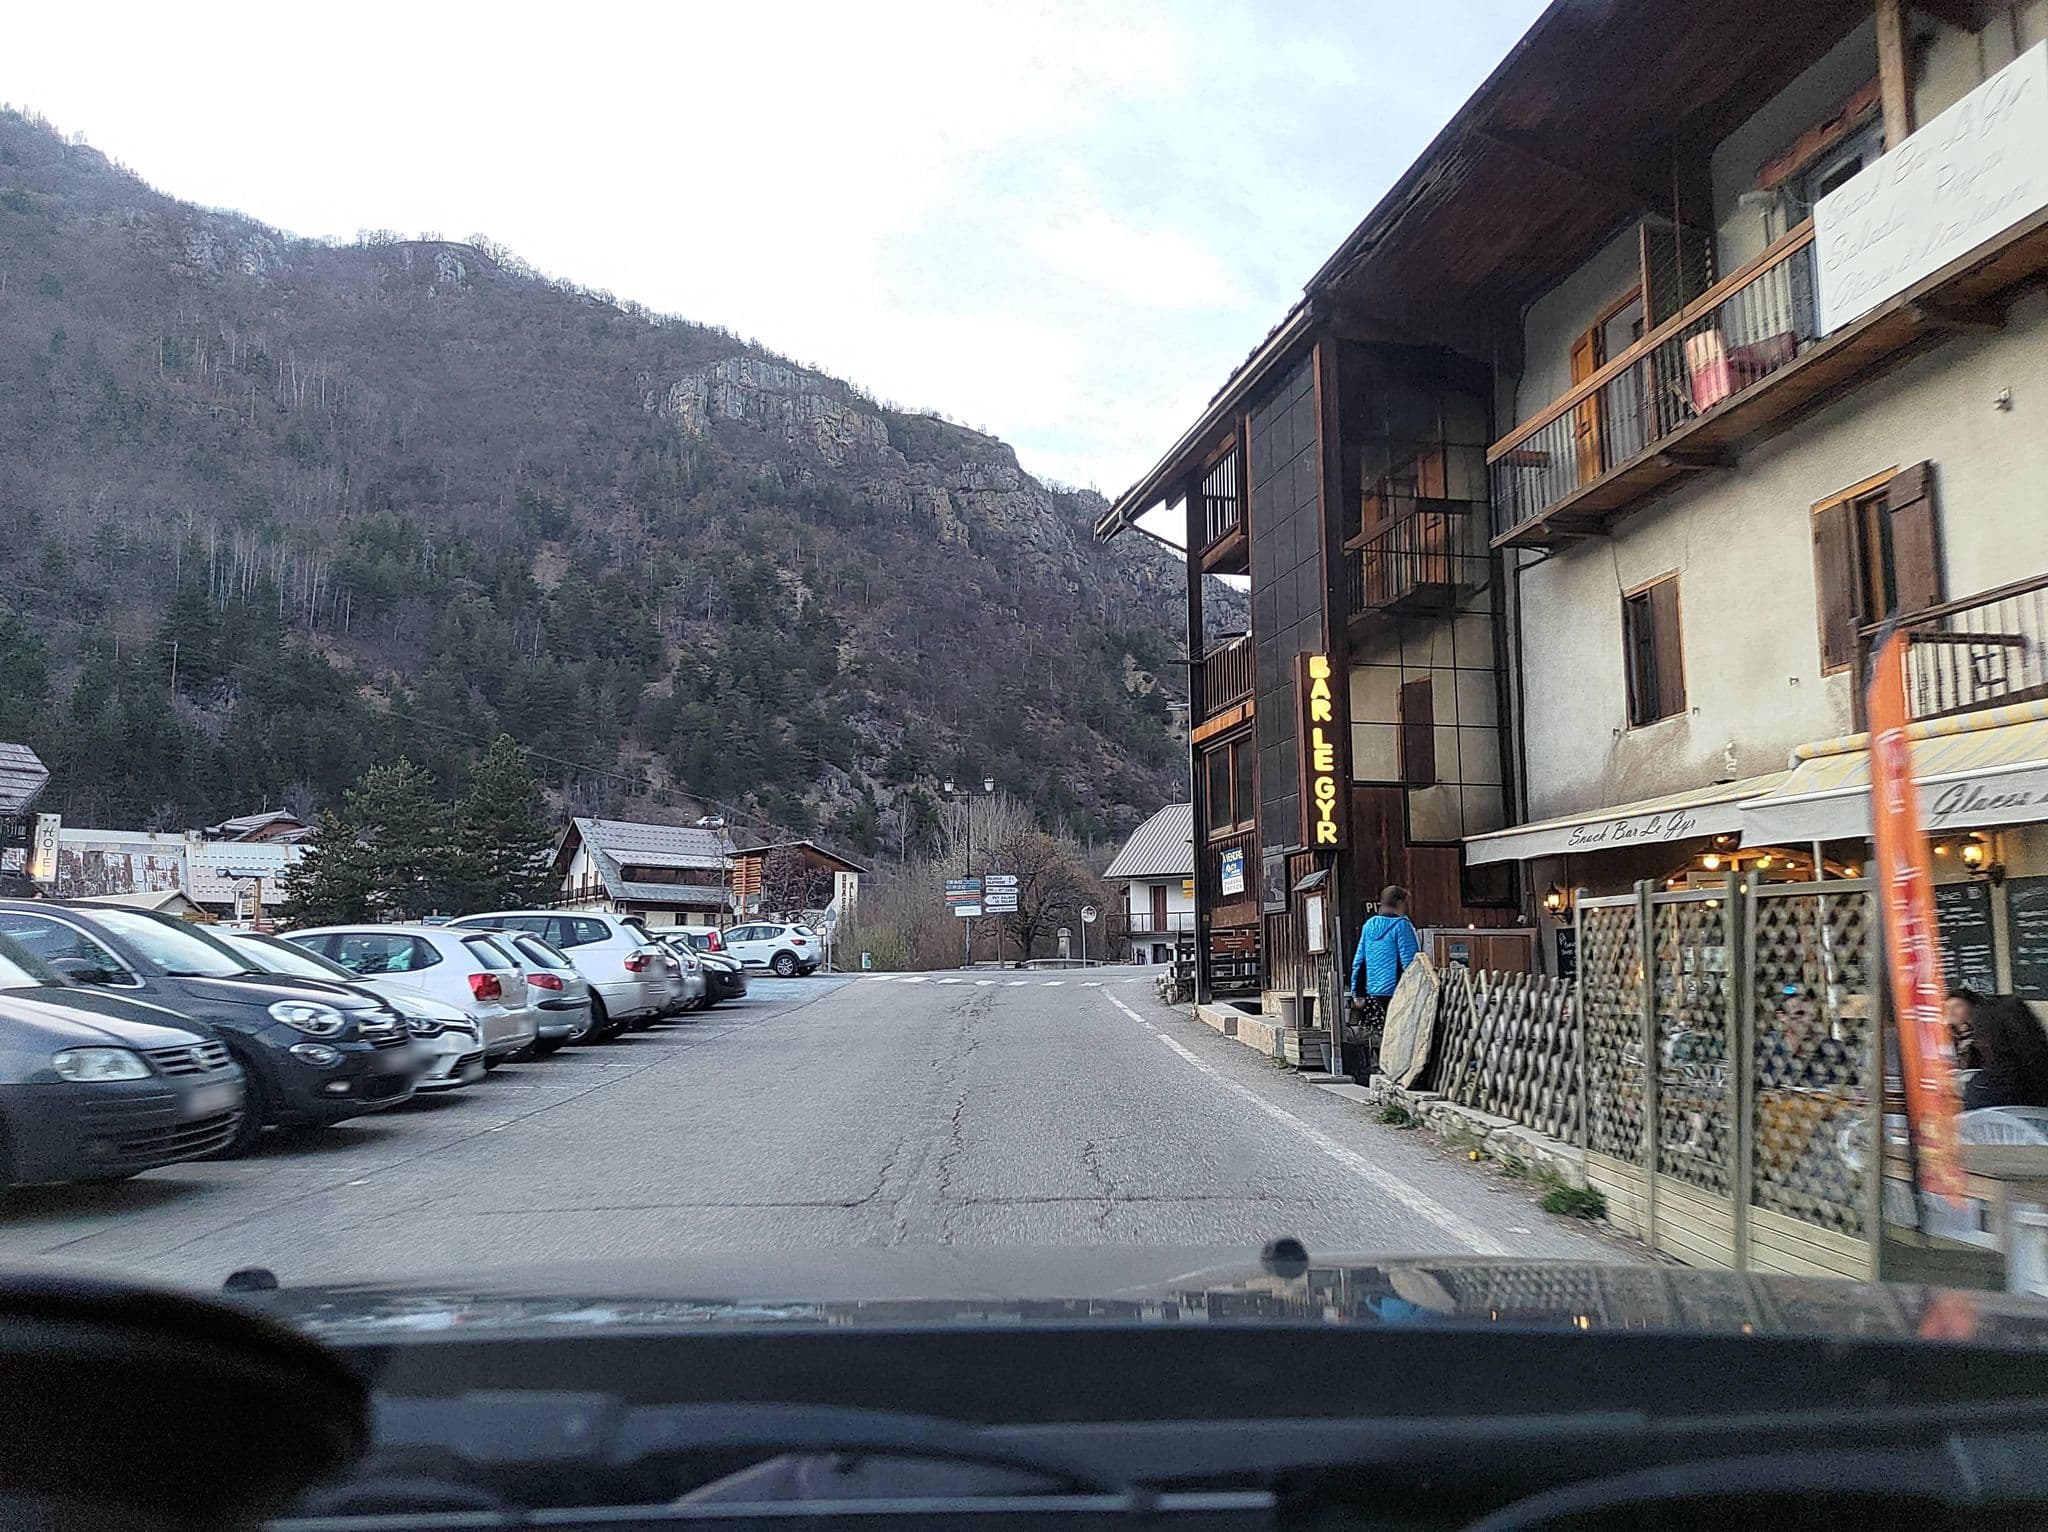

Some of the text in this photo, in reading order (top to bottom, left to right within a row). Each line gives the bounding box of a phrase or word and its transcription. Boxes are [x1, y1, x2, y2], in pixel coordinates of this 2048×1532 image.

[1309, 655, 1338, 844] BAR LE GYR
[42, 825, 56, 878] HOTEL
[1568, 810, 1697, 846] Snack Bar Le Gyr
